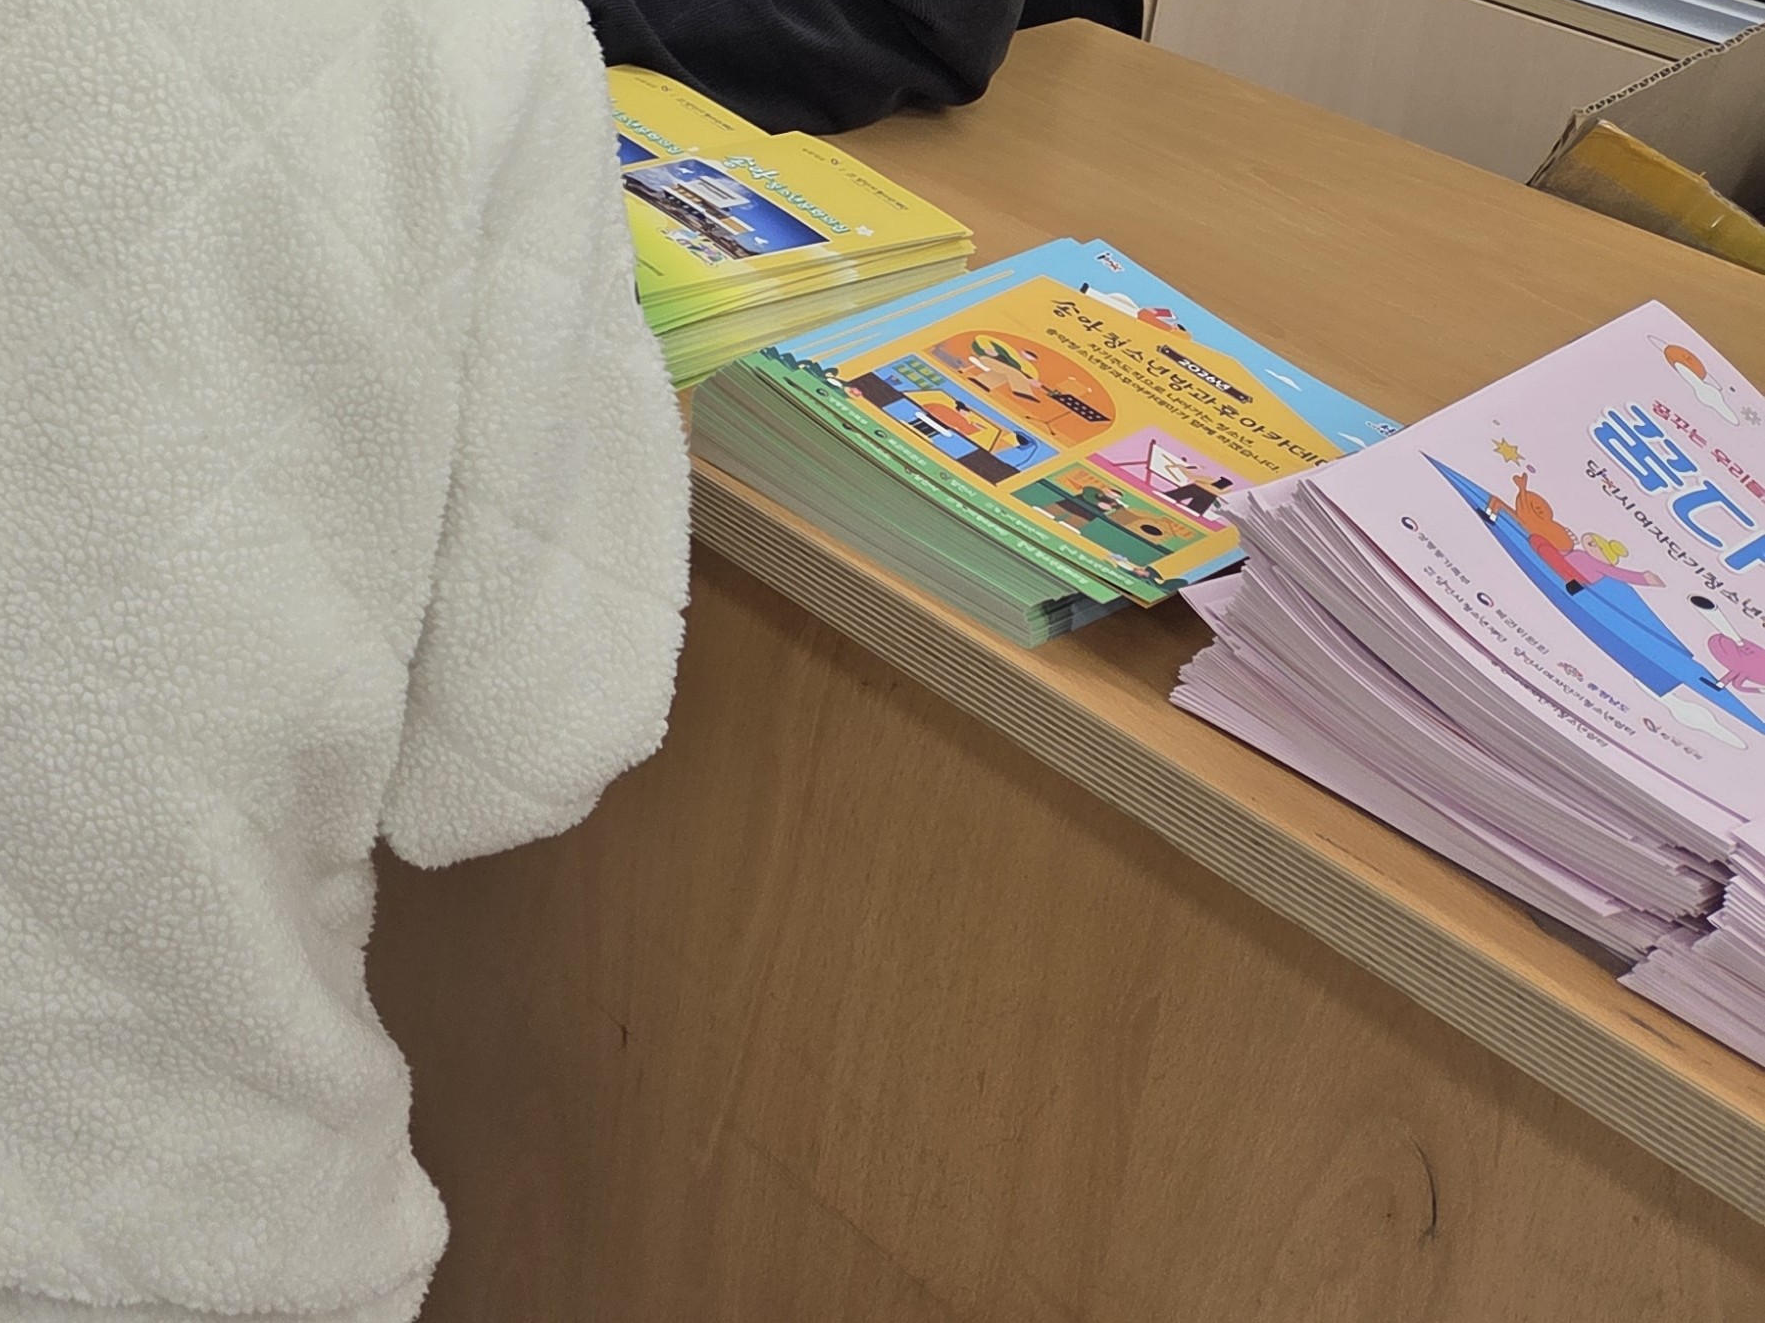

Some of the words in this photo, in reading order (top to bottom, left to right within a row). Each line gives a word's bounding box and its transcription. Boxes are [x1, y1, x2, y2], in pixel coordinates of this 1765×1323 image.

[1088, 343, 1166, 396] 자기주도적으로
[1166, 389, 1214, 424] 나아가는
[1177, 358, 1232, 393] 2026년
